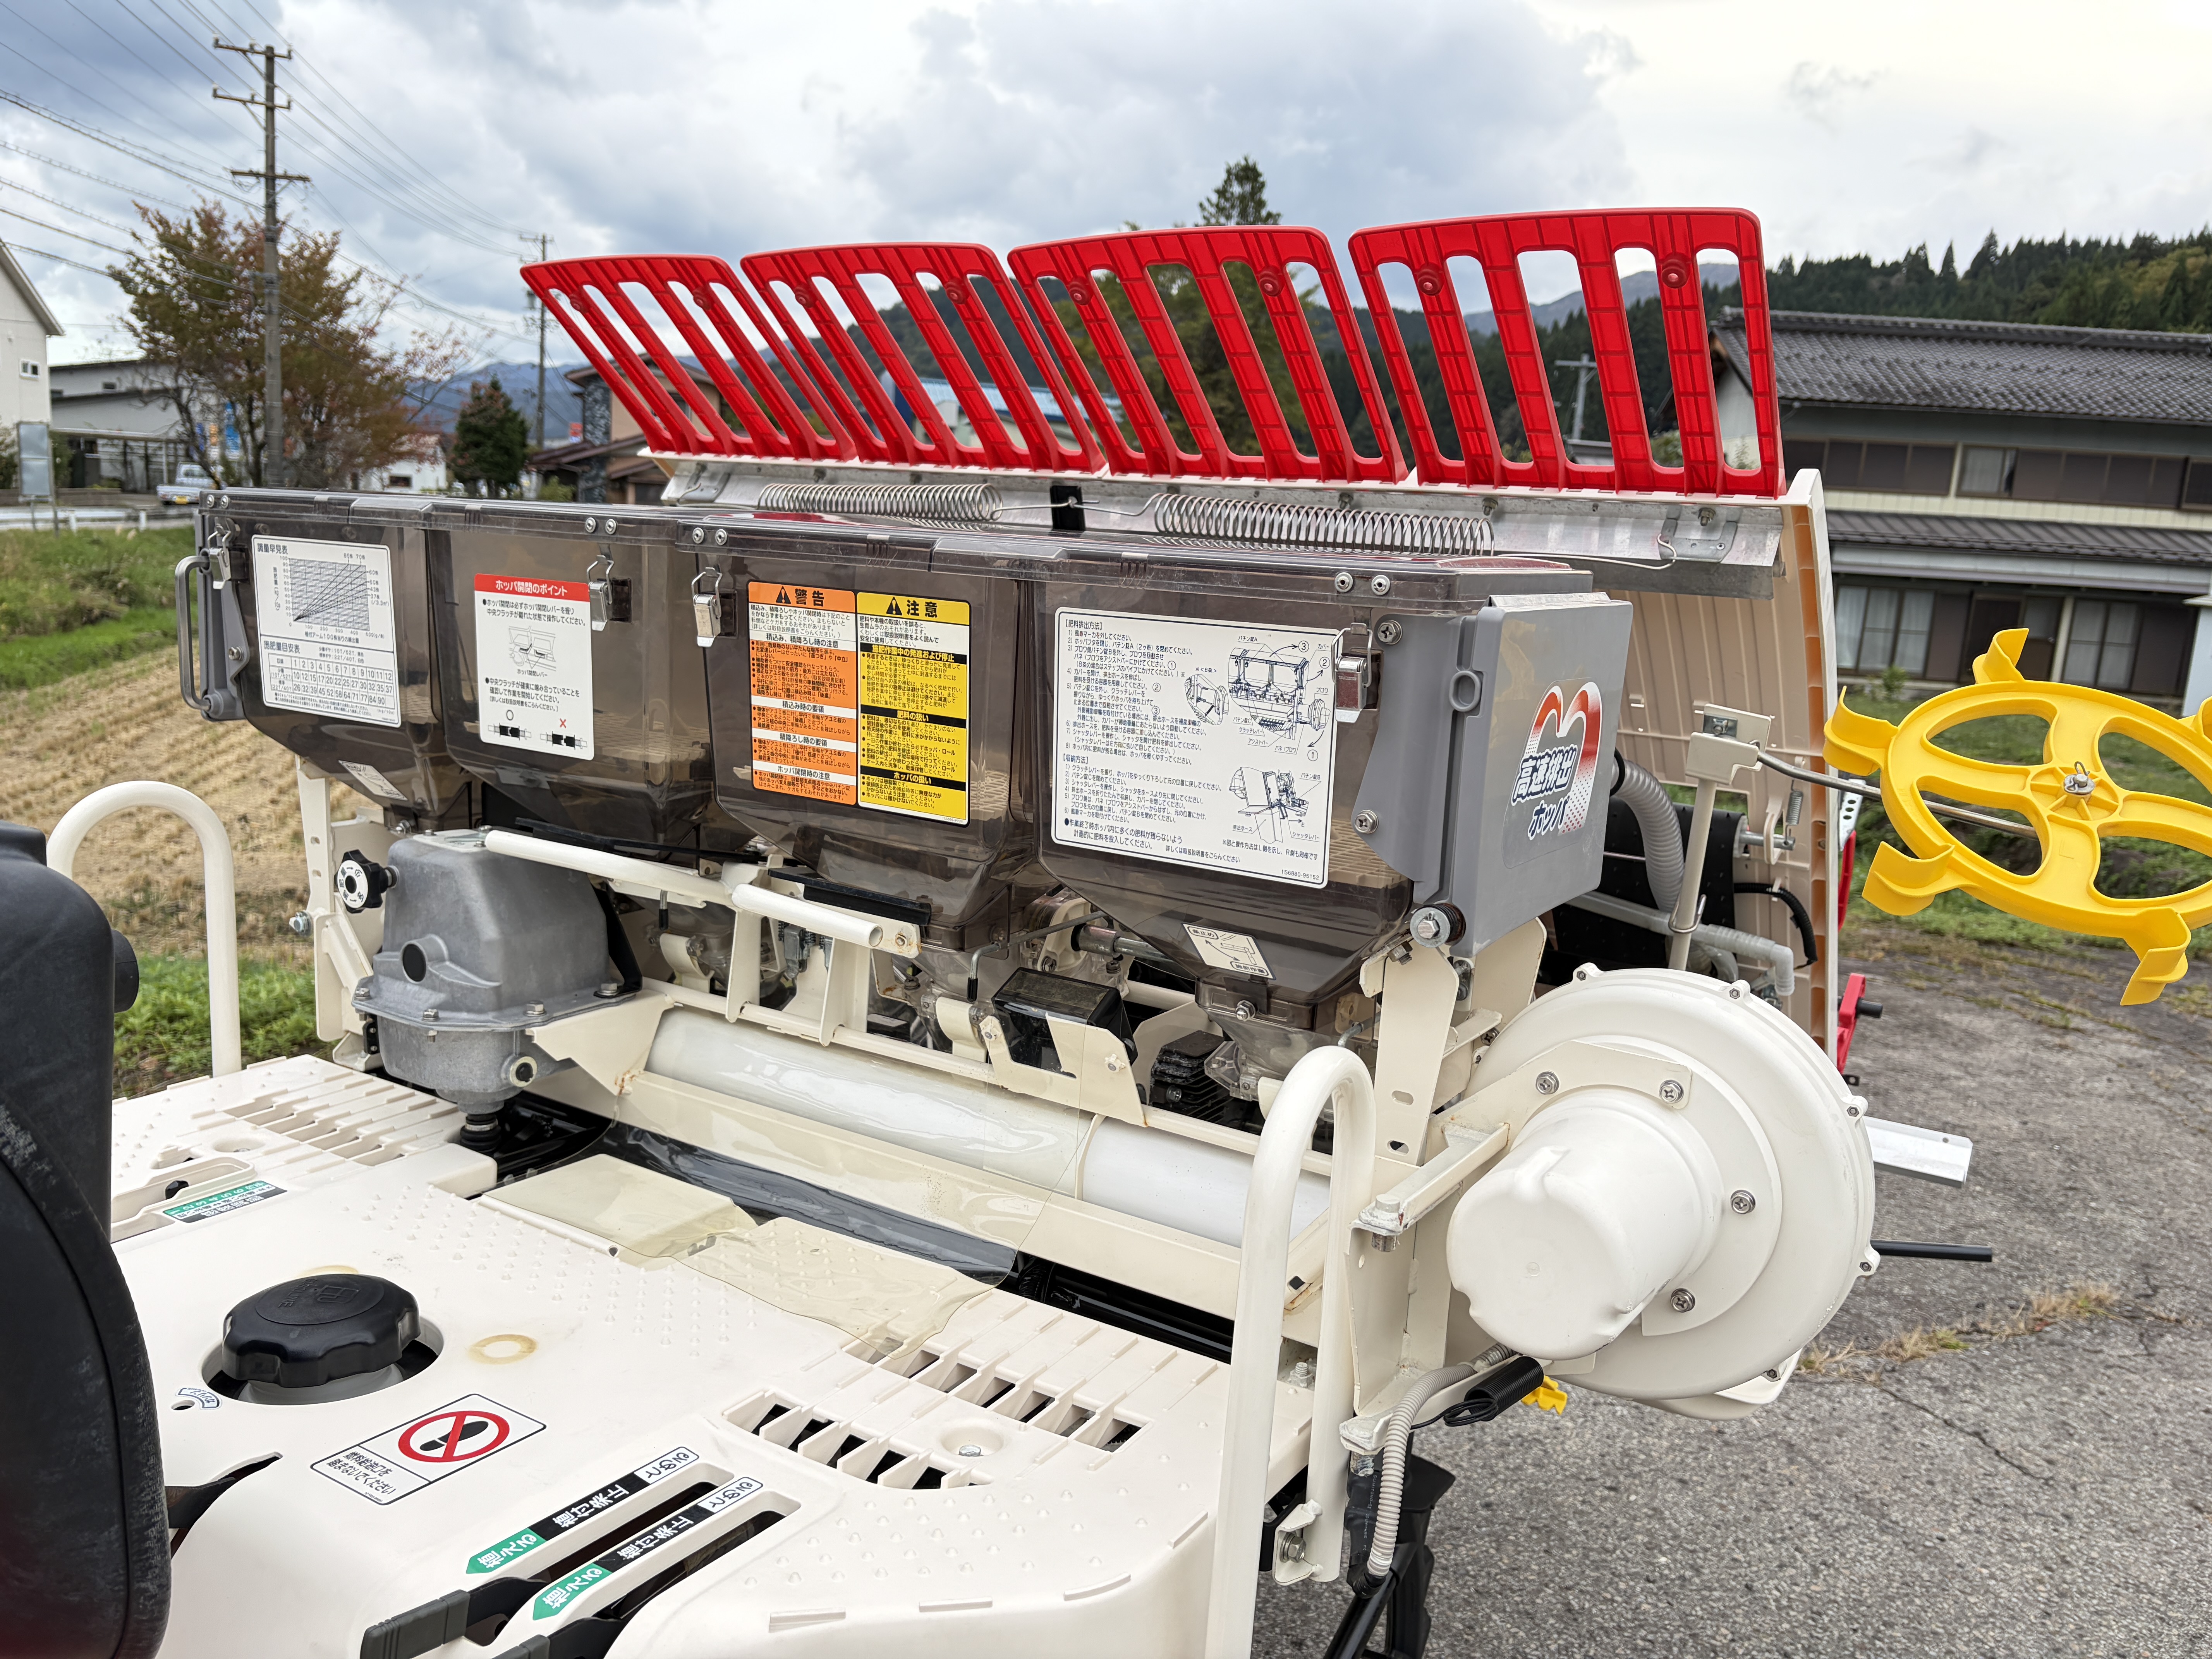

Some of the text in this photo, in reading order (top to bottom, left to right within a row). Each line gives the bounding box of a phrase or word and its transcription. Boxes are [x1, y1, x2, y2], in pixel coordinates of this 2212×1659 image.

[495, 579, 568, 597] ホッパ開閉のポイント
[795, 588, 824, 607] 警告
[907, 599, 937, 618] 注意
[860, 635, 916, 647] 安全に使用してください。
[302, 673, 307, 681] 12
[310, 674, 316, 682] 15
[318, 675, 325, 683] 17
[326, 676, 333, 684] 20
[343, 679, 350, 687] 25
[351, 680, 358, 688] 27
[360, 681, 366, 689] 30
[368, 682, 375, 691] 32
[377, 684, 384, 692] 35
[386, 685, 393, 693] 37
[368, 670, 374, 678] 10
[376, 671, 382, 679] 11
[385, 672, 392, 680] 12
[294, 684, 301, 692] 26
[302, 685, 309, 693] 32
[318, 687, 325, 696] 45
[327, 689, 333, 697] 52
[335, 690, 342, 698] 58
[343, 691, 350, 699] 64
[352, 692, 359, 701] 71
[361, 694, 367, 702] 77
[369, 695, 376, 703] 84
[378, 696, 385, 704] 90
[897, 710, 929, 722] 肥料の扱い
[778, 765, 830, 781] ホッパ開閉時の注意
[894, 771, 931, 785] ホッパの扱い
[1511, 744, 1578, 805] 高速排出
[1528, 795, 1570, 840] ホッパ
[1281, 869, 1319, 880] 1S6880-95152
[477, 1451, 691, 1569] 植える 植付条止 とめる
[542, 1481, 755, 1609] 植える 植付条止 とめる
